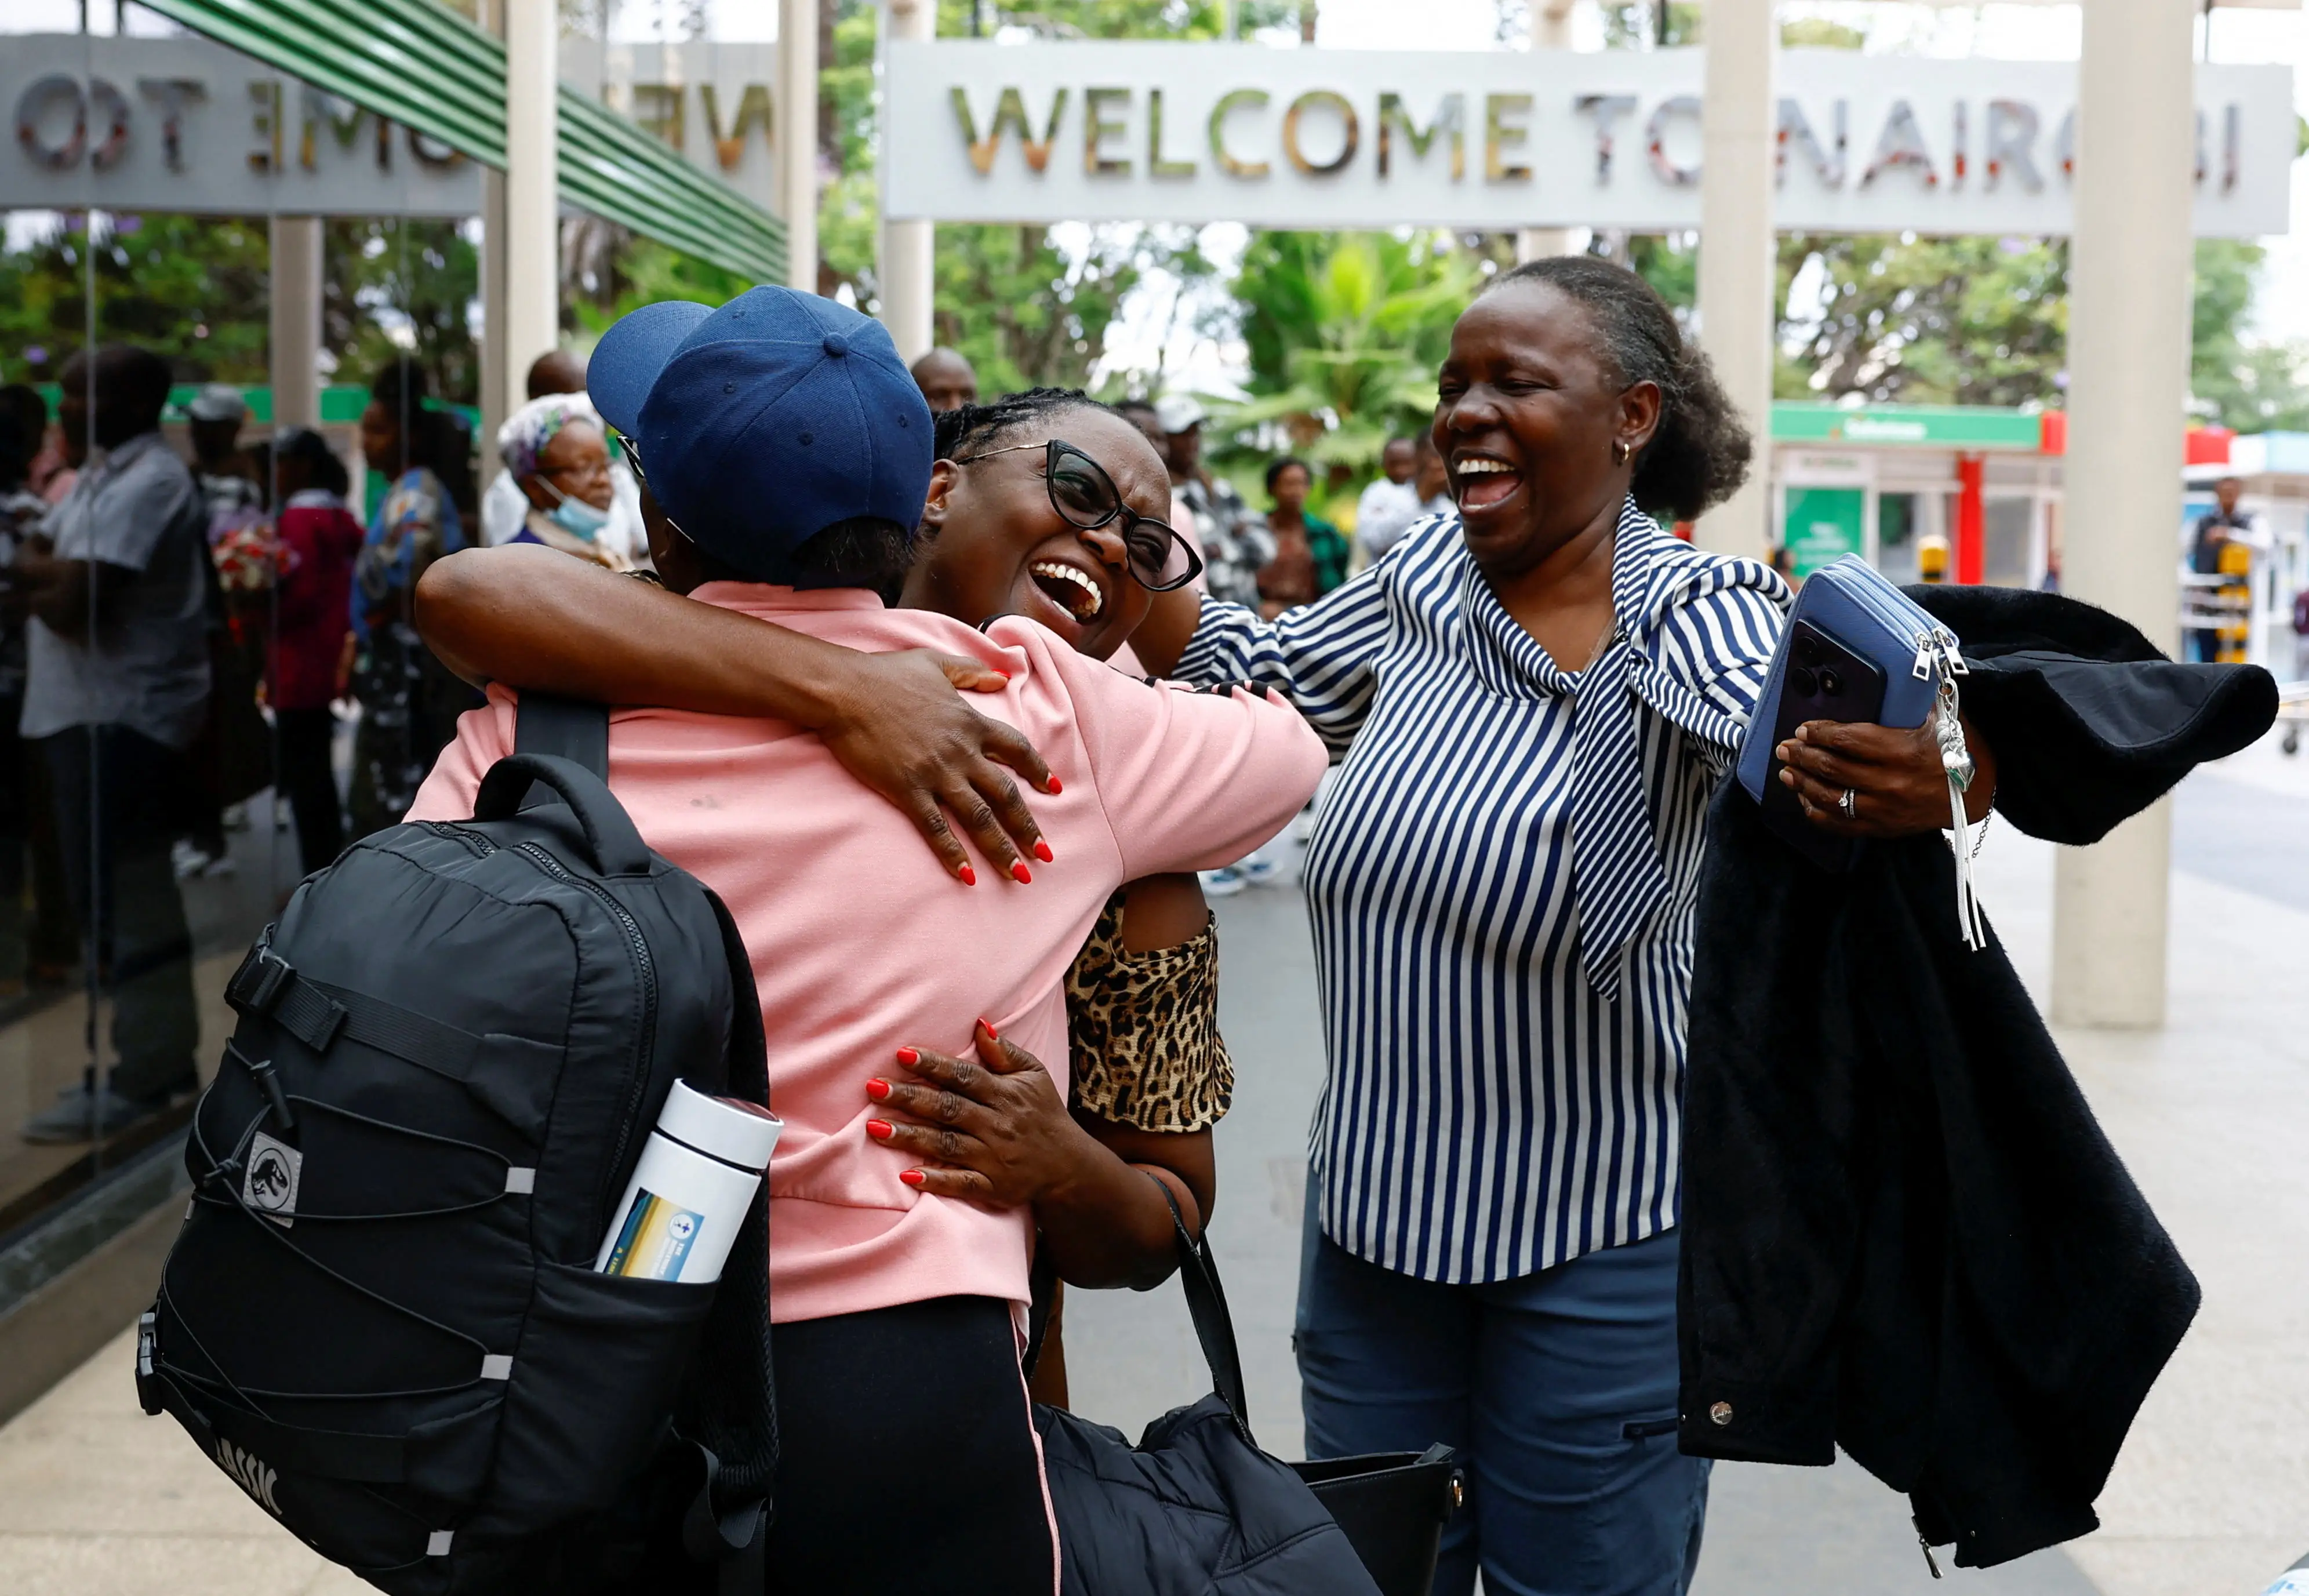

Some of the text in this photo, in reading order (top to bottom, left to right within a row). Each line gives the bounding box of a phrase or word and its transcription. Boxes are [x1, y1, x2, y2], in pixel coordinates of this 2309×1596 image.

[949, 87, 2241, 194] WELCOME TO NAIRI
